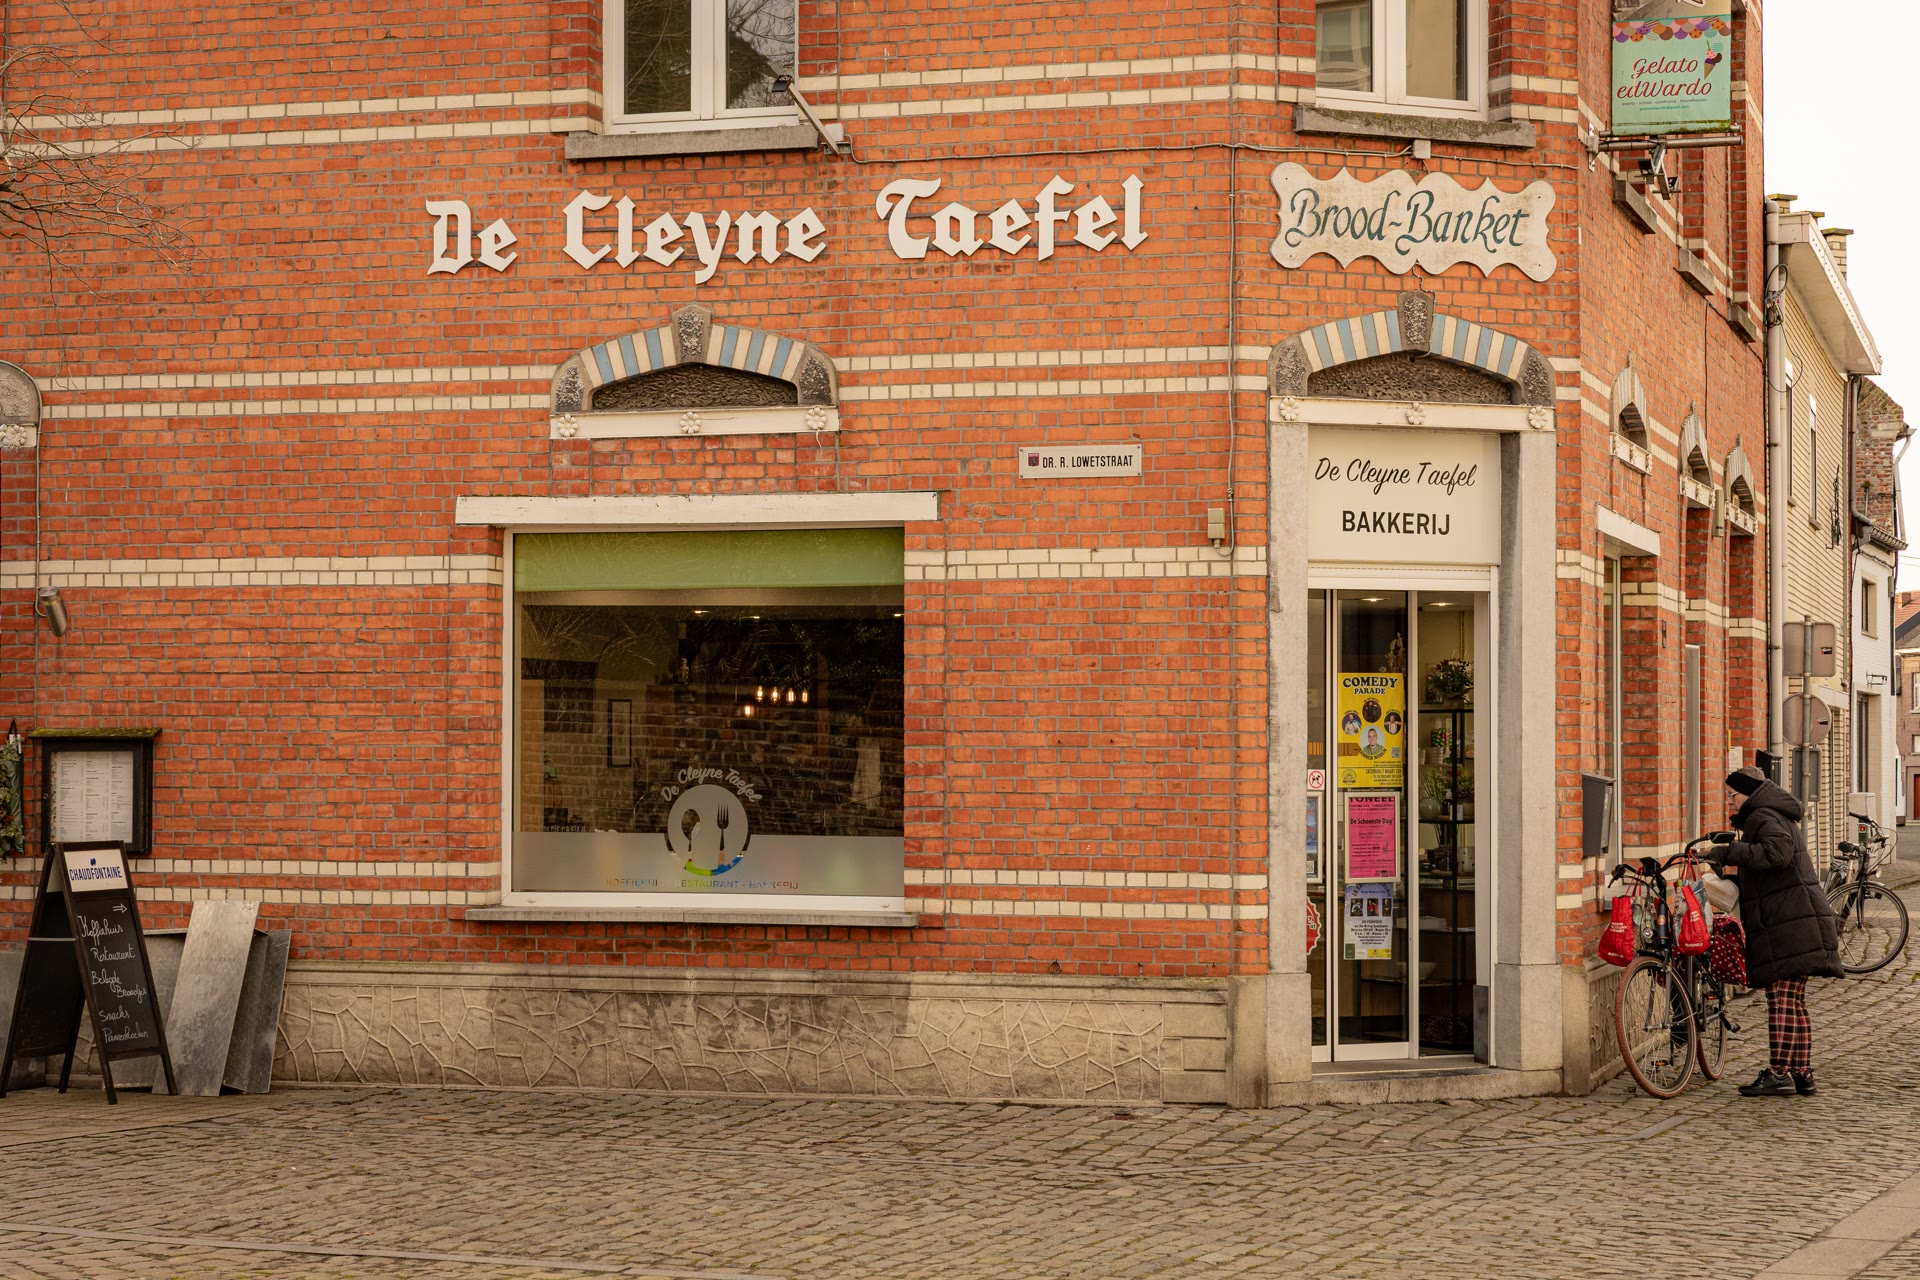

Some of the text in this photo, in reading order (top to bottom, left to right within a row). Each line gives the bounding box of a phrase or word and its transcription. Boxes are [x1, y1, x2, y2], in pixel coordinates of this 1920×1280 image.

[1631, 57, 1699, 80] Gelato
[1616, 78, 1712, 99] edWardo
[425, 173, 1149, 285] De Cleyne Taefel
[1042, 455, 1133, 468] DR. R. LOWETSTRAAT
[1314, 457, 1478, 496] De Cleyne Taefel
[1342, 510, 1451, 535] BAKKERIJ
[1342, 677, 1398, 688] COMEDY
[660, 766, 763, 802] De Cleyne Taefel
[69, 866, 122, 881] CHAUDFONTAINE
[674, 879, 740, 889] RESTAURANT
[99, 1005, 130, 1022] Snacks
